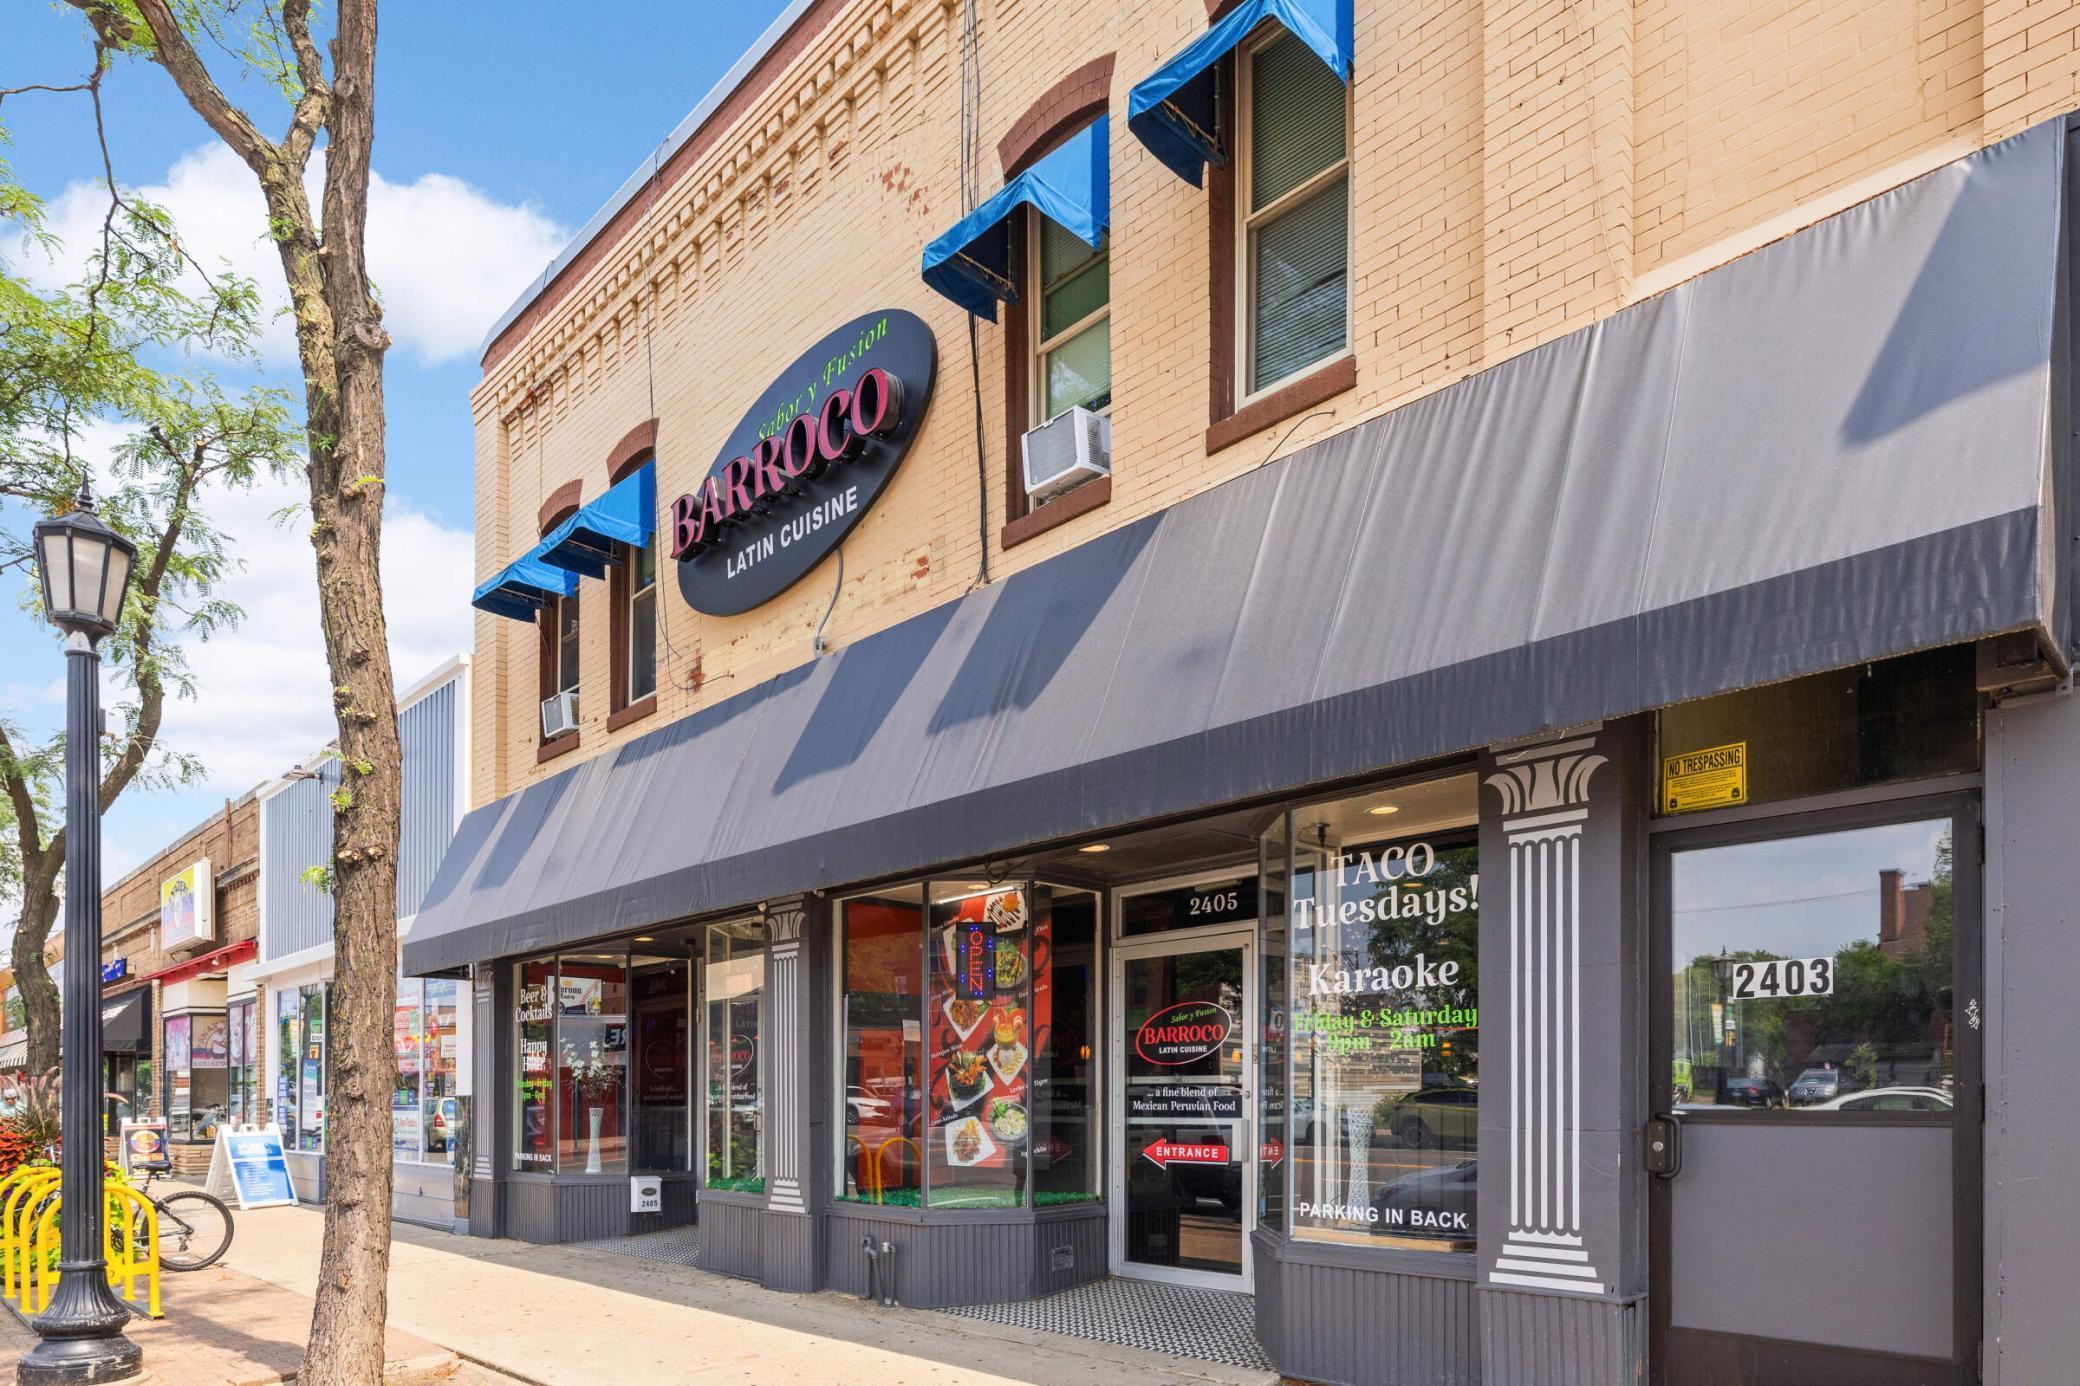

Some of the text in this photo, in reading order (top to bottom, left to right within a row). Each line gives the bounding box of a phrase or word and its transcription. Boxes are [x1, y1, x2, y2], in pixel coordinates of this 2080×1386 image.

[757, 316, 888, 440] Sabor y Fusion
[669, 366, 892, 560] BARROCO
[727, 485, 859, 579] LATIN CUISINE
[1668, 748, 1740, 777] NO TRESPASSING
[1330, 842, 1435, 888] TACO
[1189, 891, 1238, 915] 2405
[1293, 874, 1479, 929] Tuesdays!
[969, 930, 983, 992] OPEN
[1308, 953, 1460, 996] Karaoke
[1735, 958, 1830, 999] 2403
[520, 986, 548, 1005] Beer &
[515, 1005, 553, 1023] Cocktails
[1170, 1013, 1188, 1023] Sabor
[1194, 1007, 1217, 1018] Fusion
[1294, 1010, 1355, 1034] Friday
[1360, 1009, 1376, 1028] &
[1379, 1004, 1478, 1028] Saturday
[520, 1038, 547, 1056] Happy
[1143, 1024, 1225, 1045] BARROCO
[1327, 1033, 1372, 1056] 9pm
[1389, 1029, 1437, 1050] 2am
[1159, 1045, 1208, 1054] LATIN CUISINE
[1033, 1077, 1048, 1088] Tigre
[1162, 1086, 1180, 1097] fine
[1180, 1086, 1206, 1097] blend
[1208, 1086, 1218, 1097] of
[1132, 1101, 1236, 1111] Mexican Peruvian Food
[514, 1152, 533, 1161] PARKING
[539, 1154, 552, 1162] BACK
[1155, 1146, 1219, 1158] ENTRANCE
[1299, 1202, 1468, 1229] PARKING IN BACK
